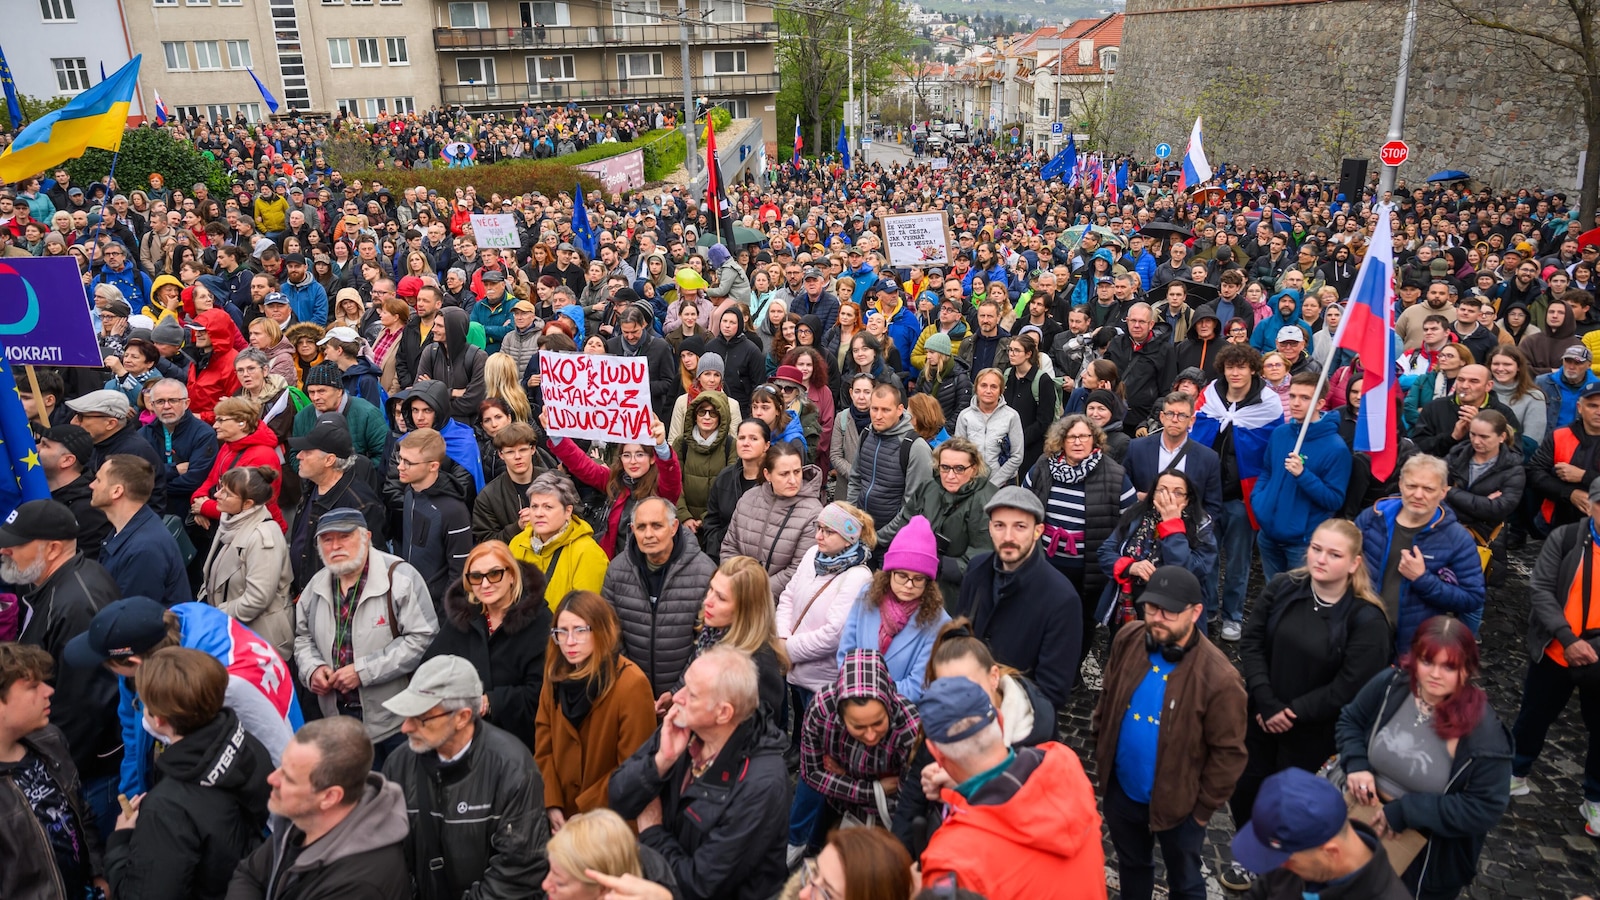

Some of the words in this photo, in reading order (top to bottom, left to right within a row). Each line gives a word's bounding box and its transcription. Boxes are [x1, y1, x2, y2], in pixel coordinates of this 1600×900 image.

[1382, 147, 1407, 159] STOP
[540, 355, 577, 386] AKO
[577, 355, 594, 371] SA
[587, 369, 600, 390] K
[600, 360, 645, 385] ĽUDU
[596, 388, 619, 407] SA
[619, 389, 640, 409] Z
